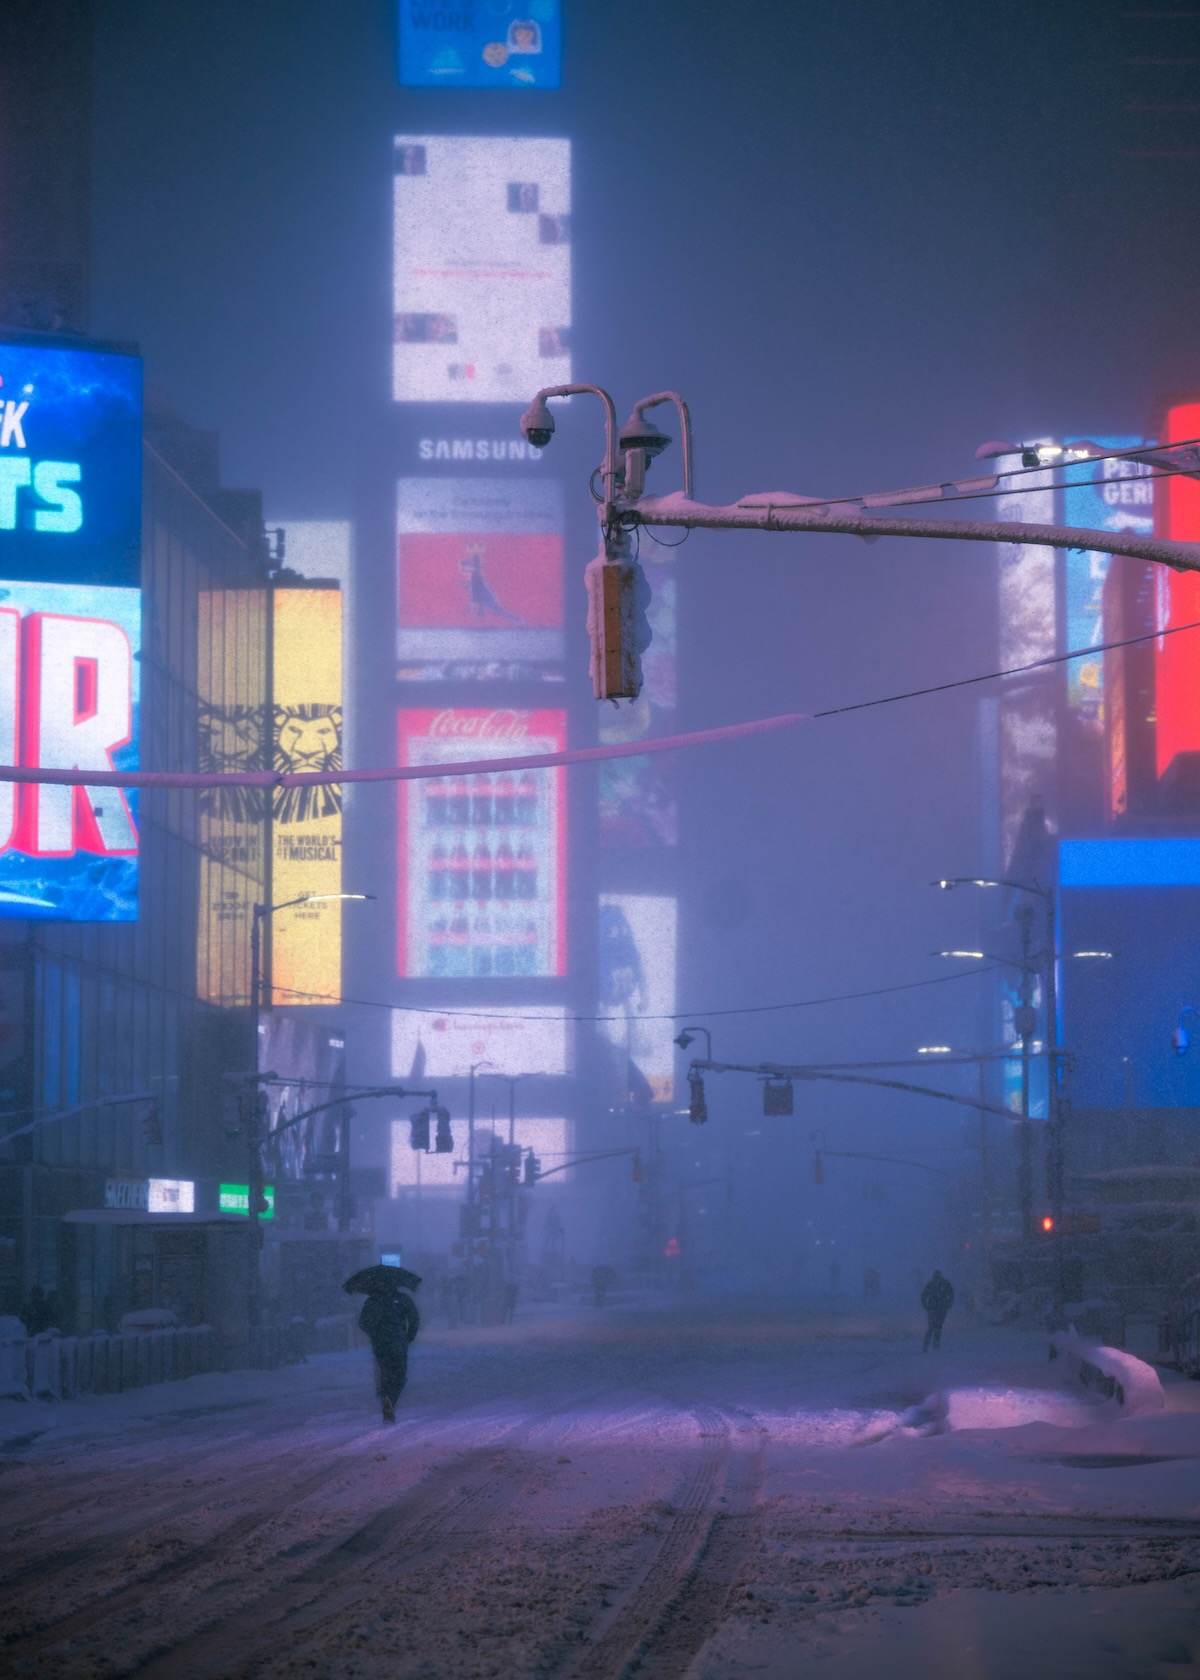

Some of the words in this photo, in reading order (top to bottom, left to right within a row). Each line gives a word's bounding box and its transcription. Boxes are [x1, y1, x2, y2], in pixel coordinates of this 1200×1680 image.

[0, 399, 29, 449] K
[0, 606, 139, 858] R
[278, 834, 294, 846] THE
[297, 834, 336, 847] WORLD'S
[289, 846, 338, 862] MUSICAL
[294, 911, 320, 920] HERE
